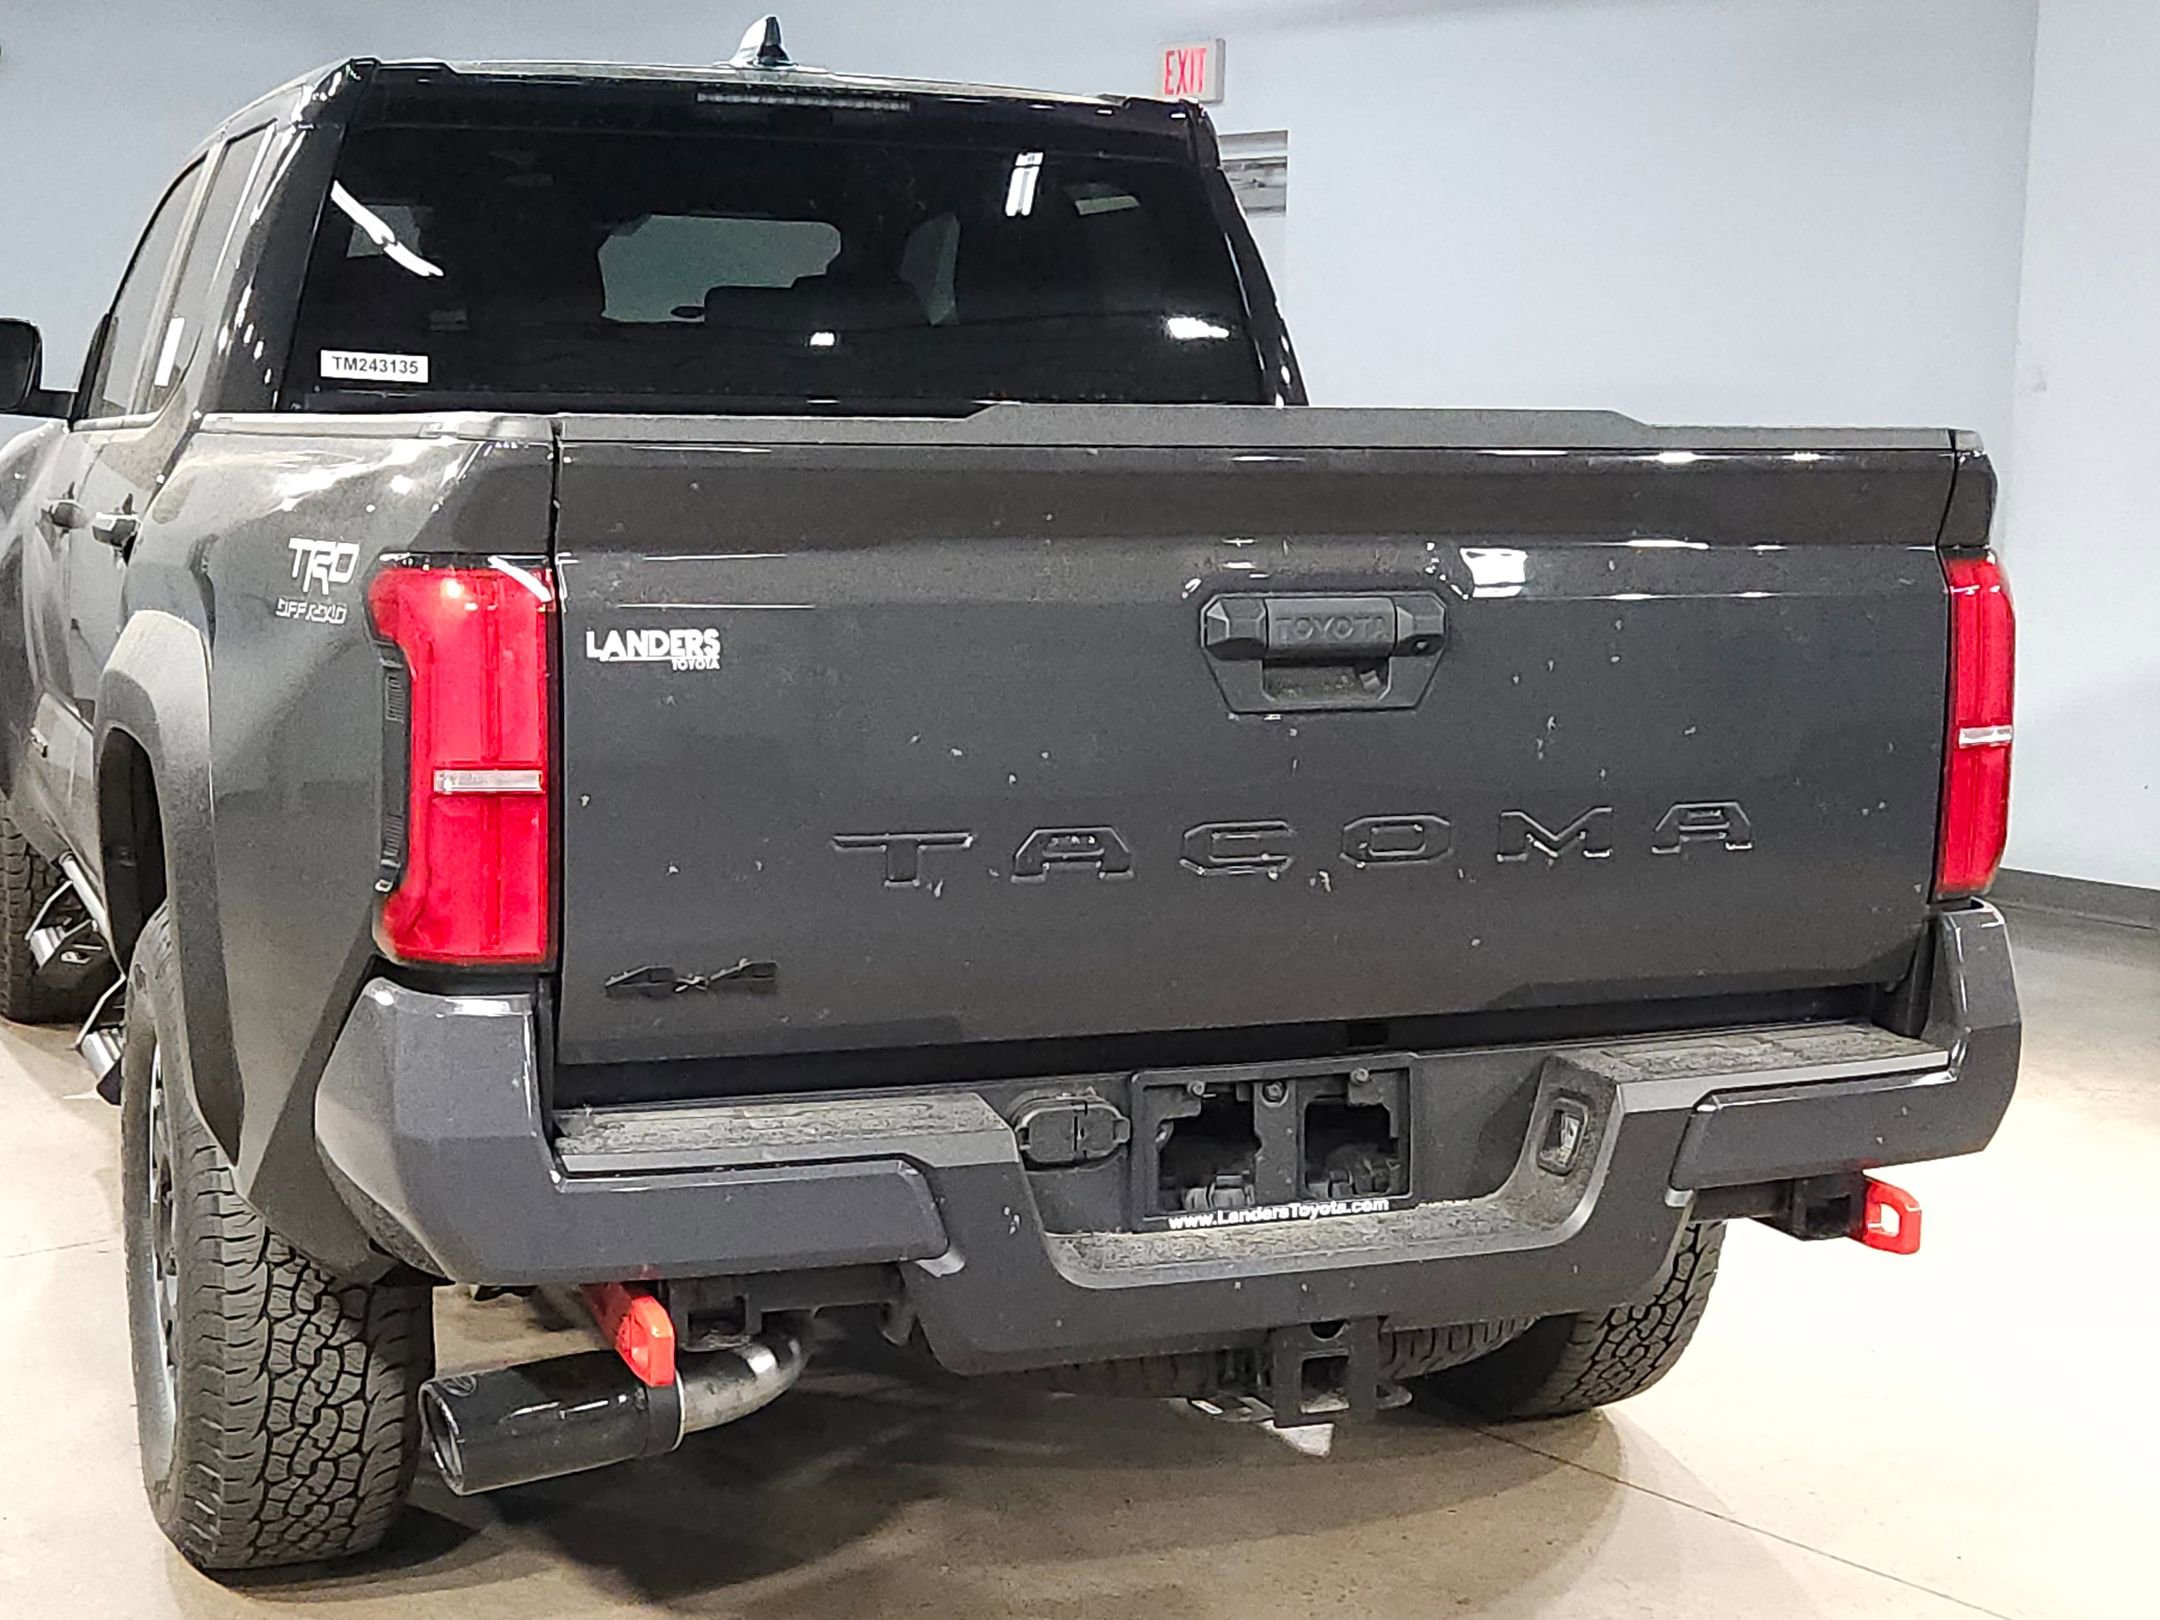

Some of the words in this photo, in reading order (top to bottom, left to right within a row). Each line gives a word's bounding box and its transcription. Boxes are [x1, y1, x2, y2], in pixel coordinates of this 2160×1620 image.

[1164, 49, 1207, 96] EXIT
[331, 355, 419, 375] TM243135
[288, 537, 360, 595] TRD
[586, 628, 721, 659] LANDERS
[1275, 614, 1388, 642] TOYOTA
[671, 657, 720, 671] TOYOTA
[831, 801, 1754, 887] TACOMA
[1168, 1199, 1389, 1230] www.LandersToyota.com
